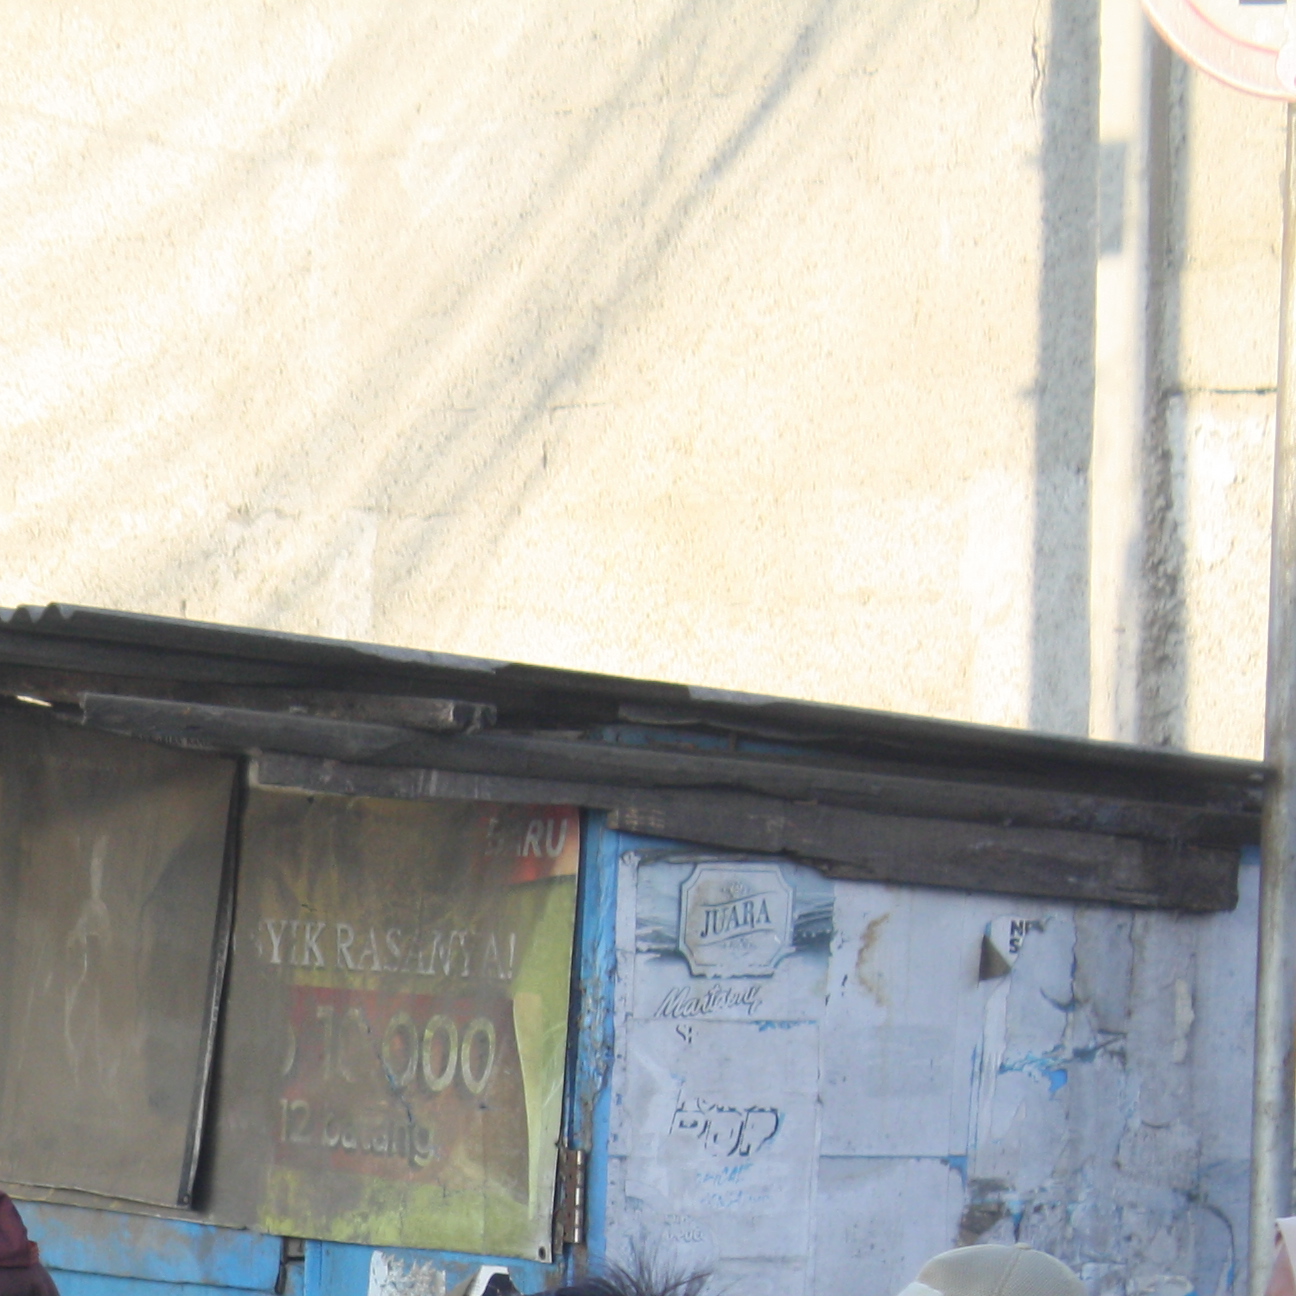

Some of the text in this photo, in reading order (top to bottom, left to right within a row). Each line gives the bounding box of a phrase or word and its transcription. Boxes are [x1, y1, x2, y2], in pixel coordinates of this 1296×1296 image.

[485, 816, 568, 858] BRU
[699, 896, 772, 939] JUARA
[256, 918, 328, 969] YIK
